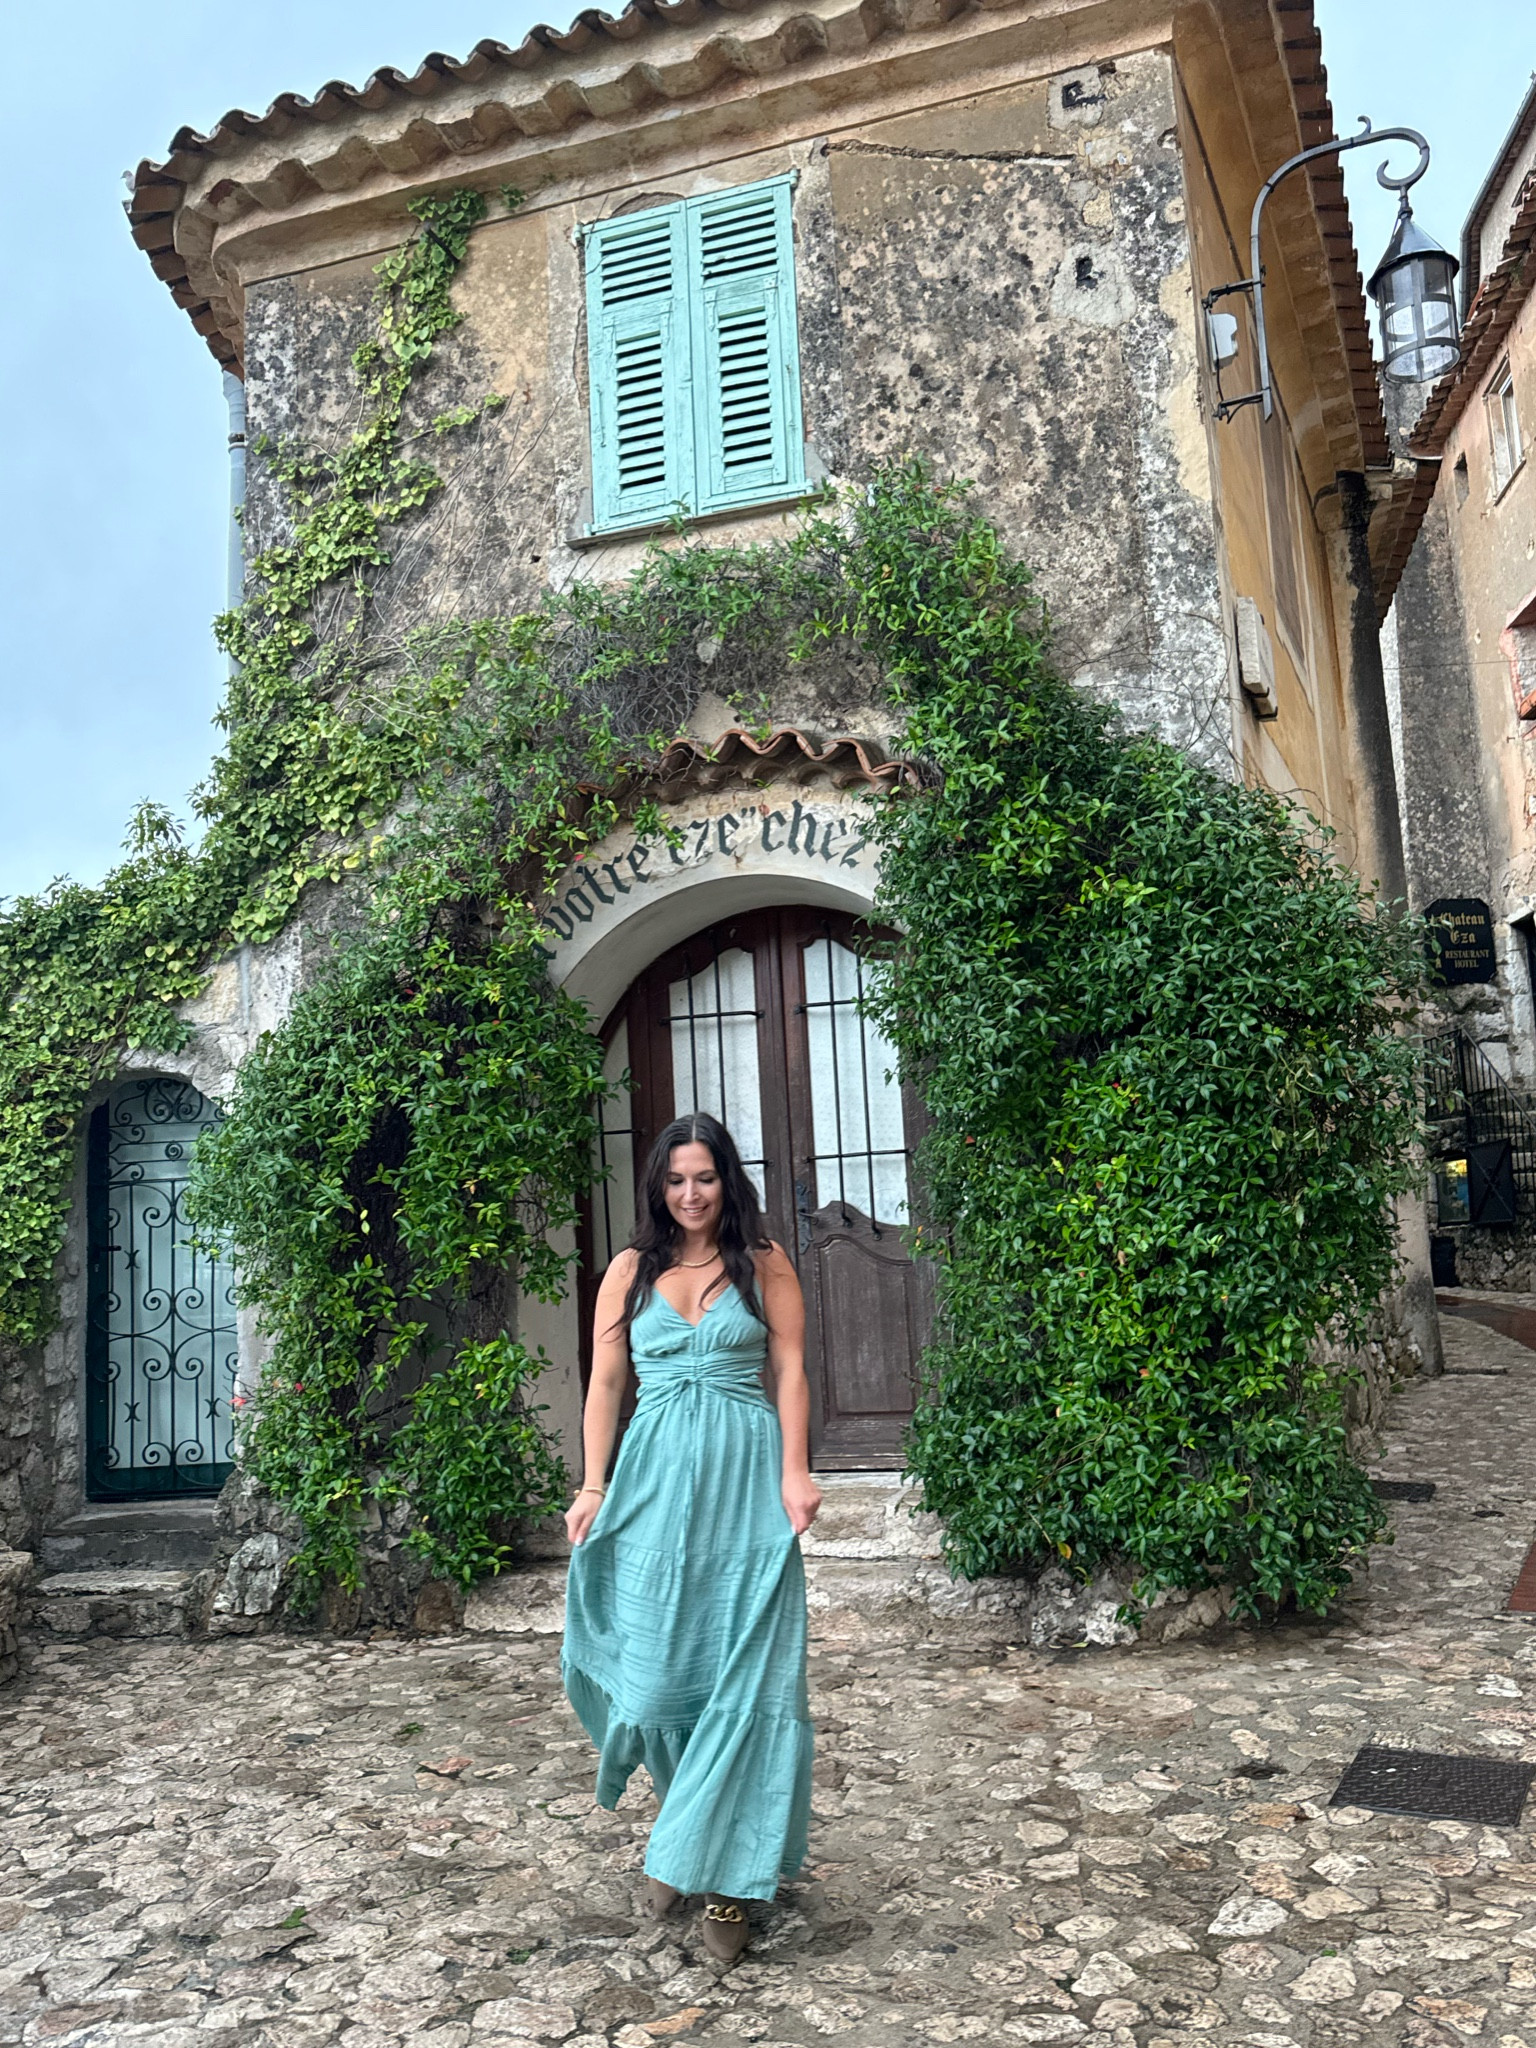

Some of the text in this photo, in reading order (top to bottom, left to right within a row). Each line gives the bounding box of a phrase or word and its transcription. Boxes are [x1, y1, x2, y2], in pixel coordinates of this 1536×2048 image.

[541, 843, 653, 941] votre
[760, 799, 873, 868] chez
[1450, 930, 1476, 944] Eza
[1445, 949, 1490, 959] RESTAURANT
[1454, 959, 1479, 969] HOTEL
